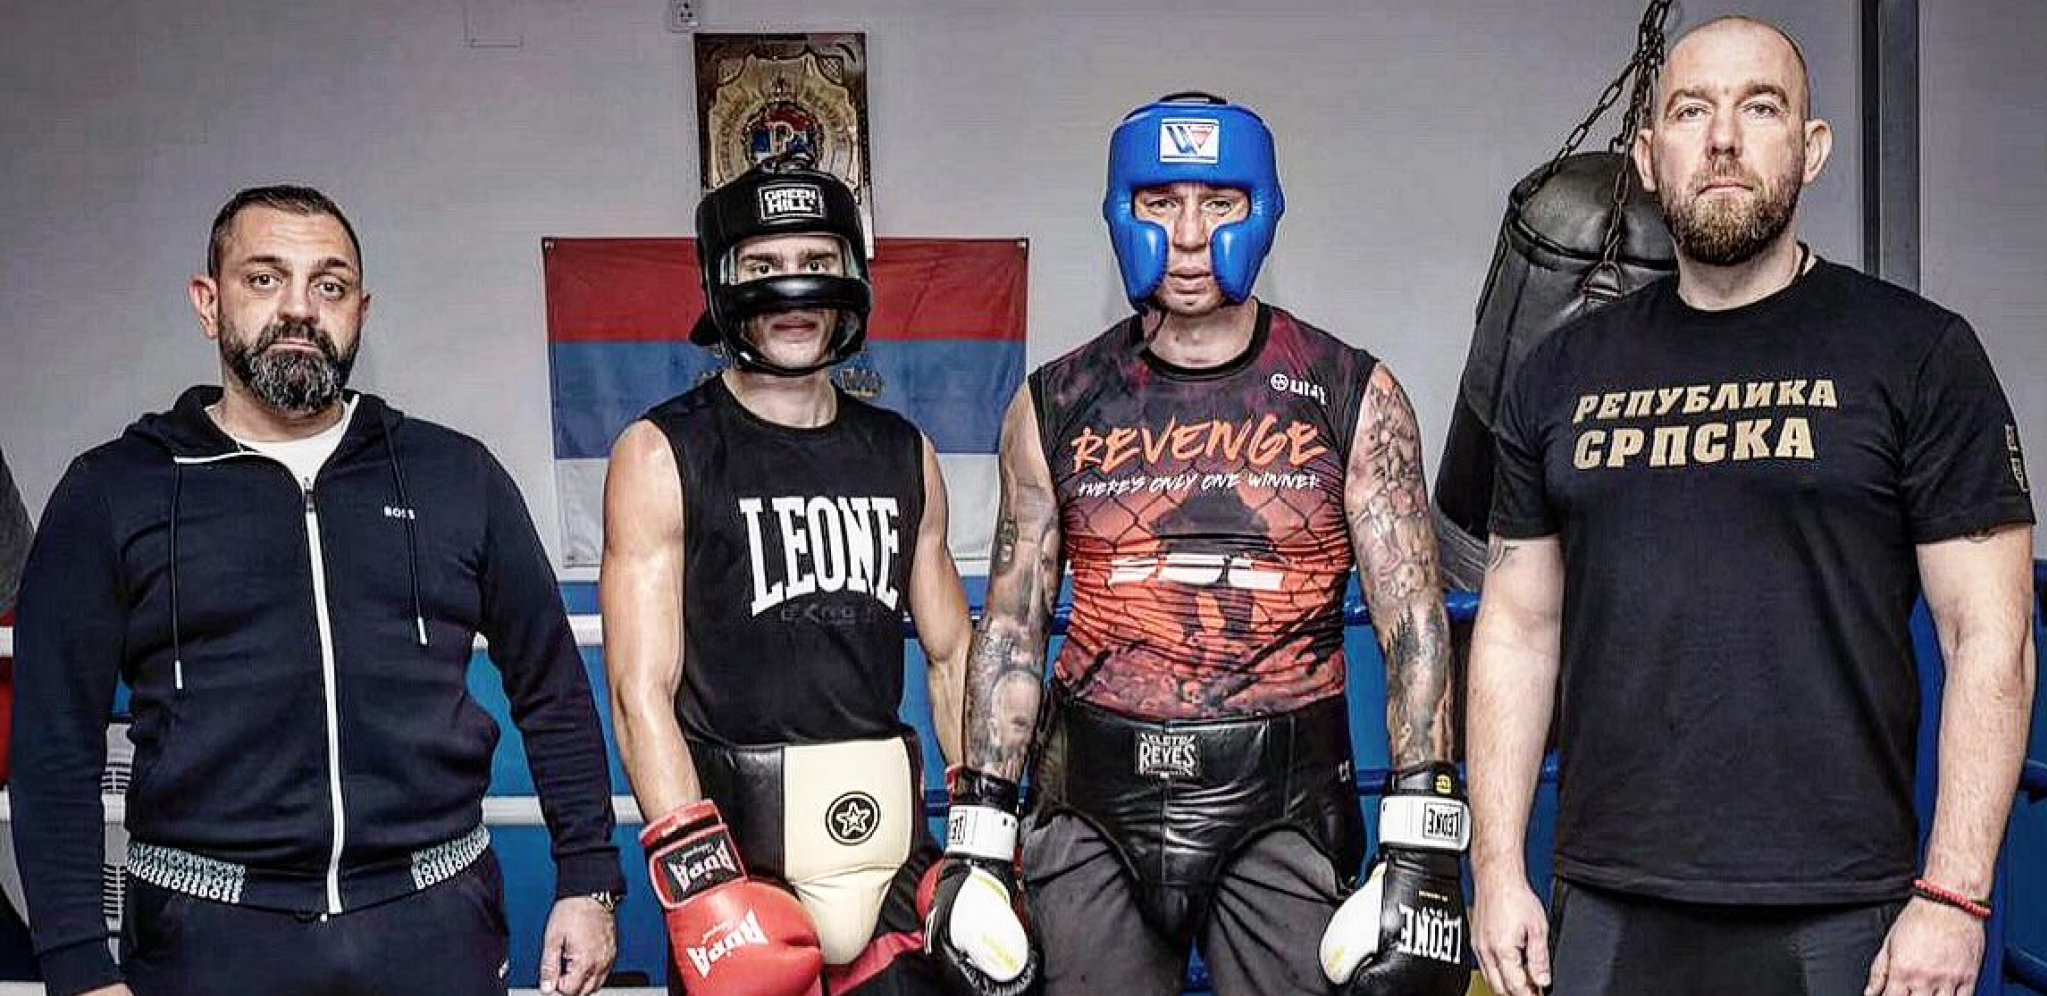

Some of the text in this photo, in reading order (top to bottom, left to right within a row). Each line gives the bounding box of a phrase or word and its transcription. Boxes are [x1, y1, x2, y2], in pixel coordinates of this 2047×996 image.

[765, 188, 815, 200] GREEN
[768, 198, 813, 213] HILL
[1572, 379, 1838, 423] РЕПУБЛИКА
[1071, 413, 1328, 474] REVENGE
[1573, 416, 1816, 470] СРПСКА
[1149, 473, 1198, 493] ONLY
[1201, 473, 1241, 490] ONE
[738, 495, 900, 617] LEONE
[1140, 742, 1196, 777] REYES
[1427, 808, 1461, 838] LEONE
[1398, 903, 1461, 965] LEONE
